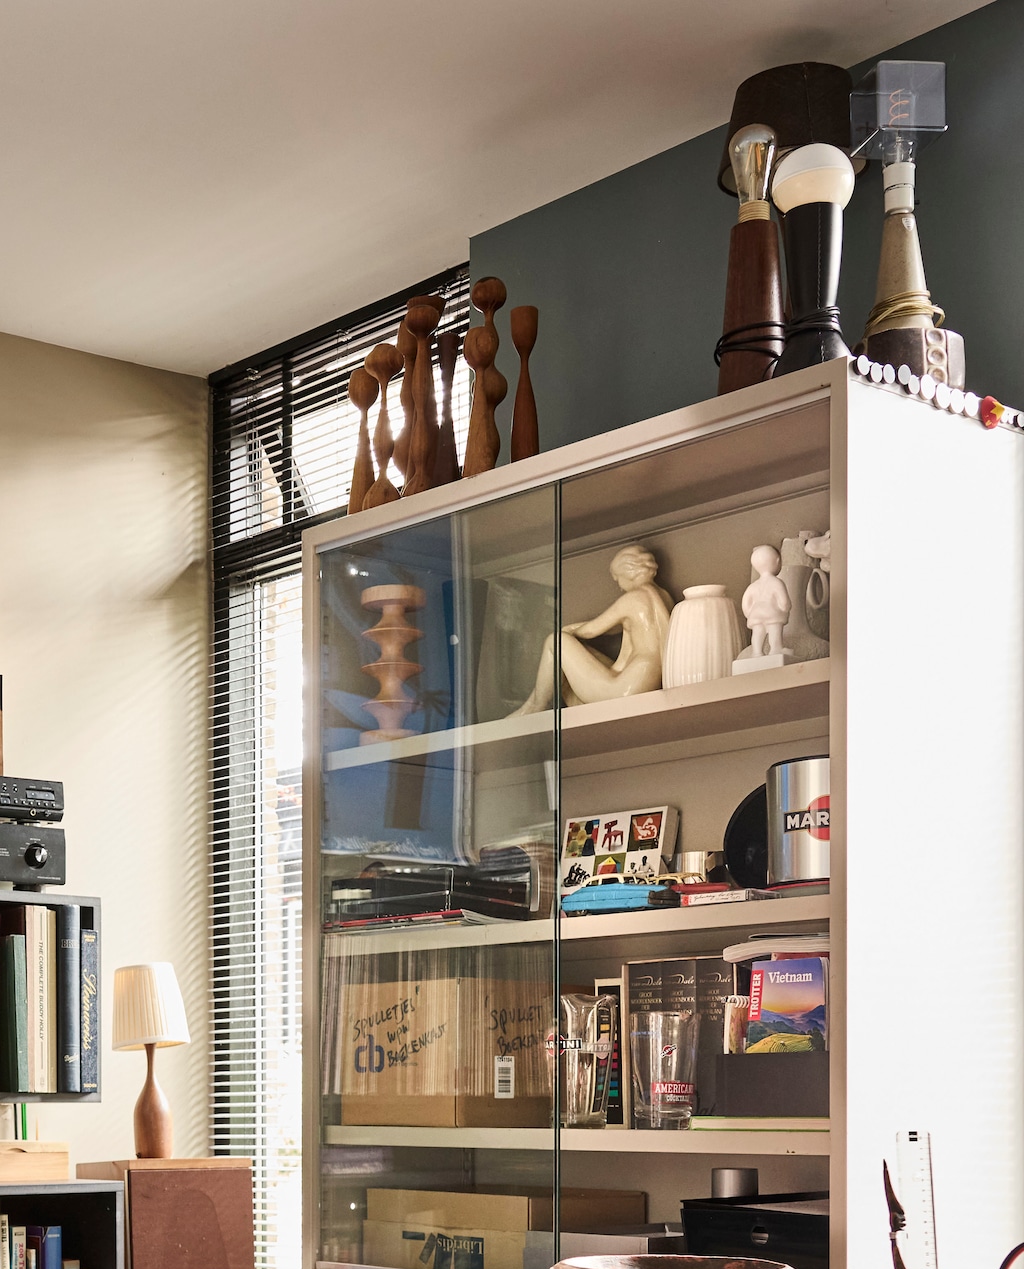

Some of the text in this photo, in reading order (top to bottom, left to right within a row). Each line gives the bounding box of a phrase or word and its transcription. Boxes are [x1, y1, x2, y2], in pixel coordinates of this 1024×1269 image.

[787, 811, 830, 830] MAR
[768, 971, 812, 984] Vietnam
[750, 974, 761, 1017] TROTTER
[83, 969, 96, 1051] Steinweiss
[436, 1238, 483, 1255] Libridis
